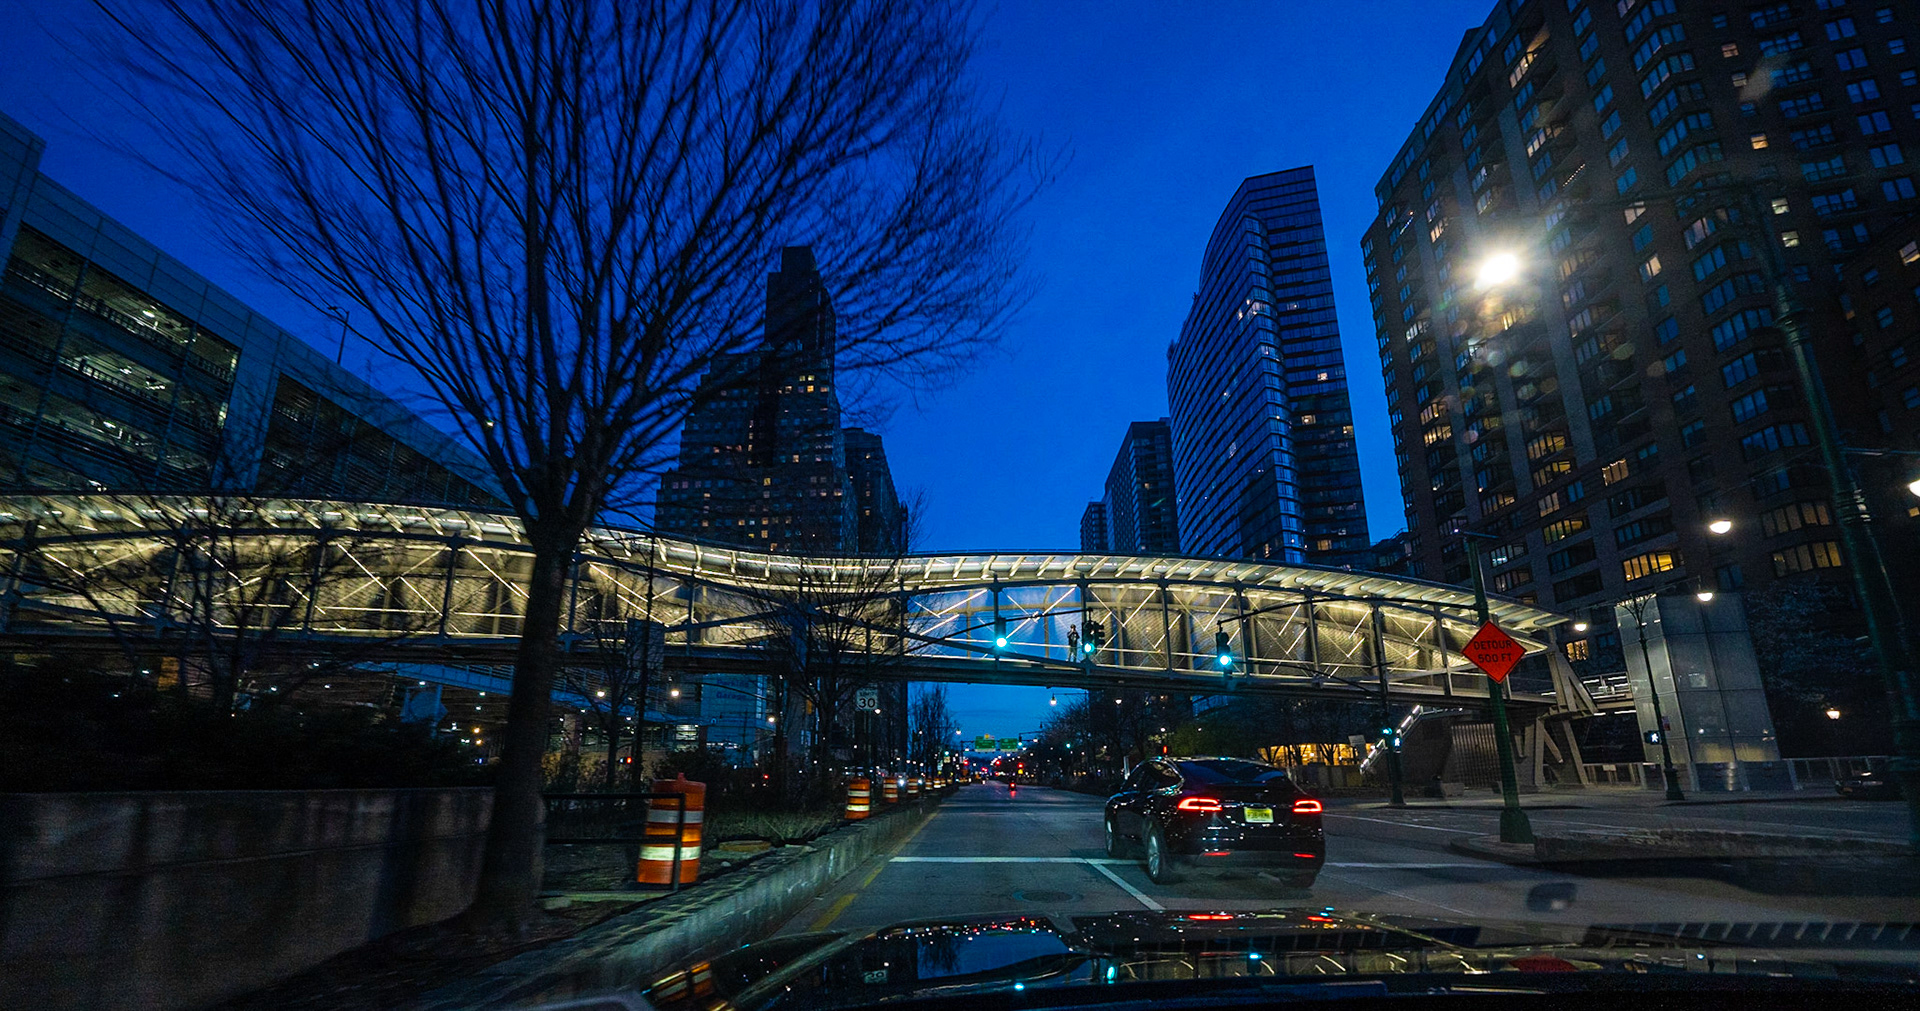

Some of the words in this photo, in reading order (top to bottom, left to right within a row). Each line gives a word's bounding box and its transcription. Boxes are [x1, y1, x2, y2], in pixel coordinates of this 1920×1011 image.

[1473, 640, 1512, 650] DETOUR
[1478, 654, 1498, 663] 500
[1501, 653, 1512, 661] FT
[859, 698, 876, 708] 30
